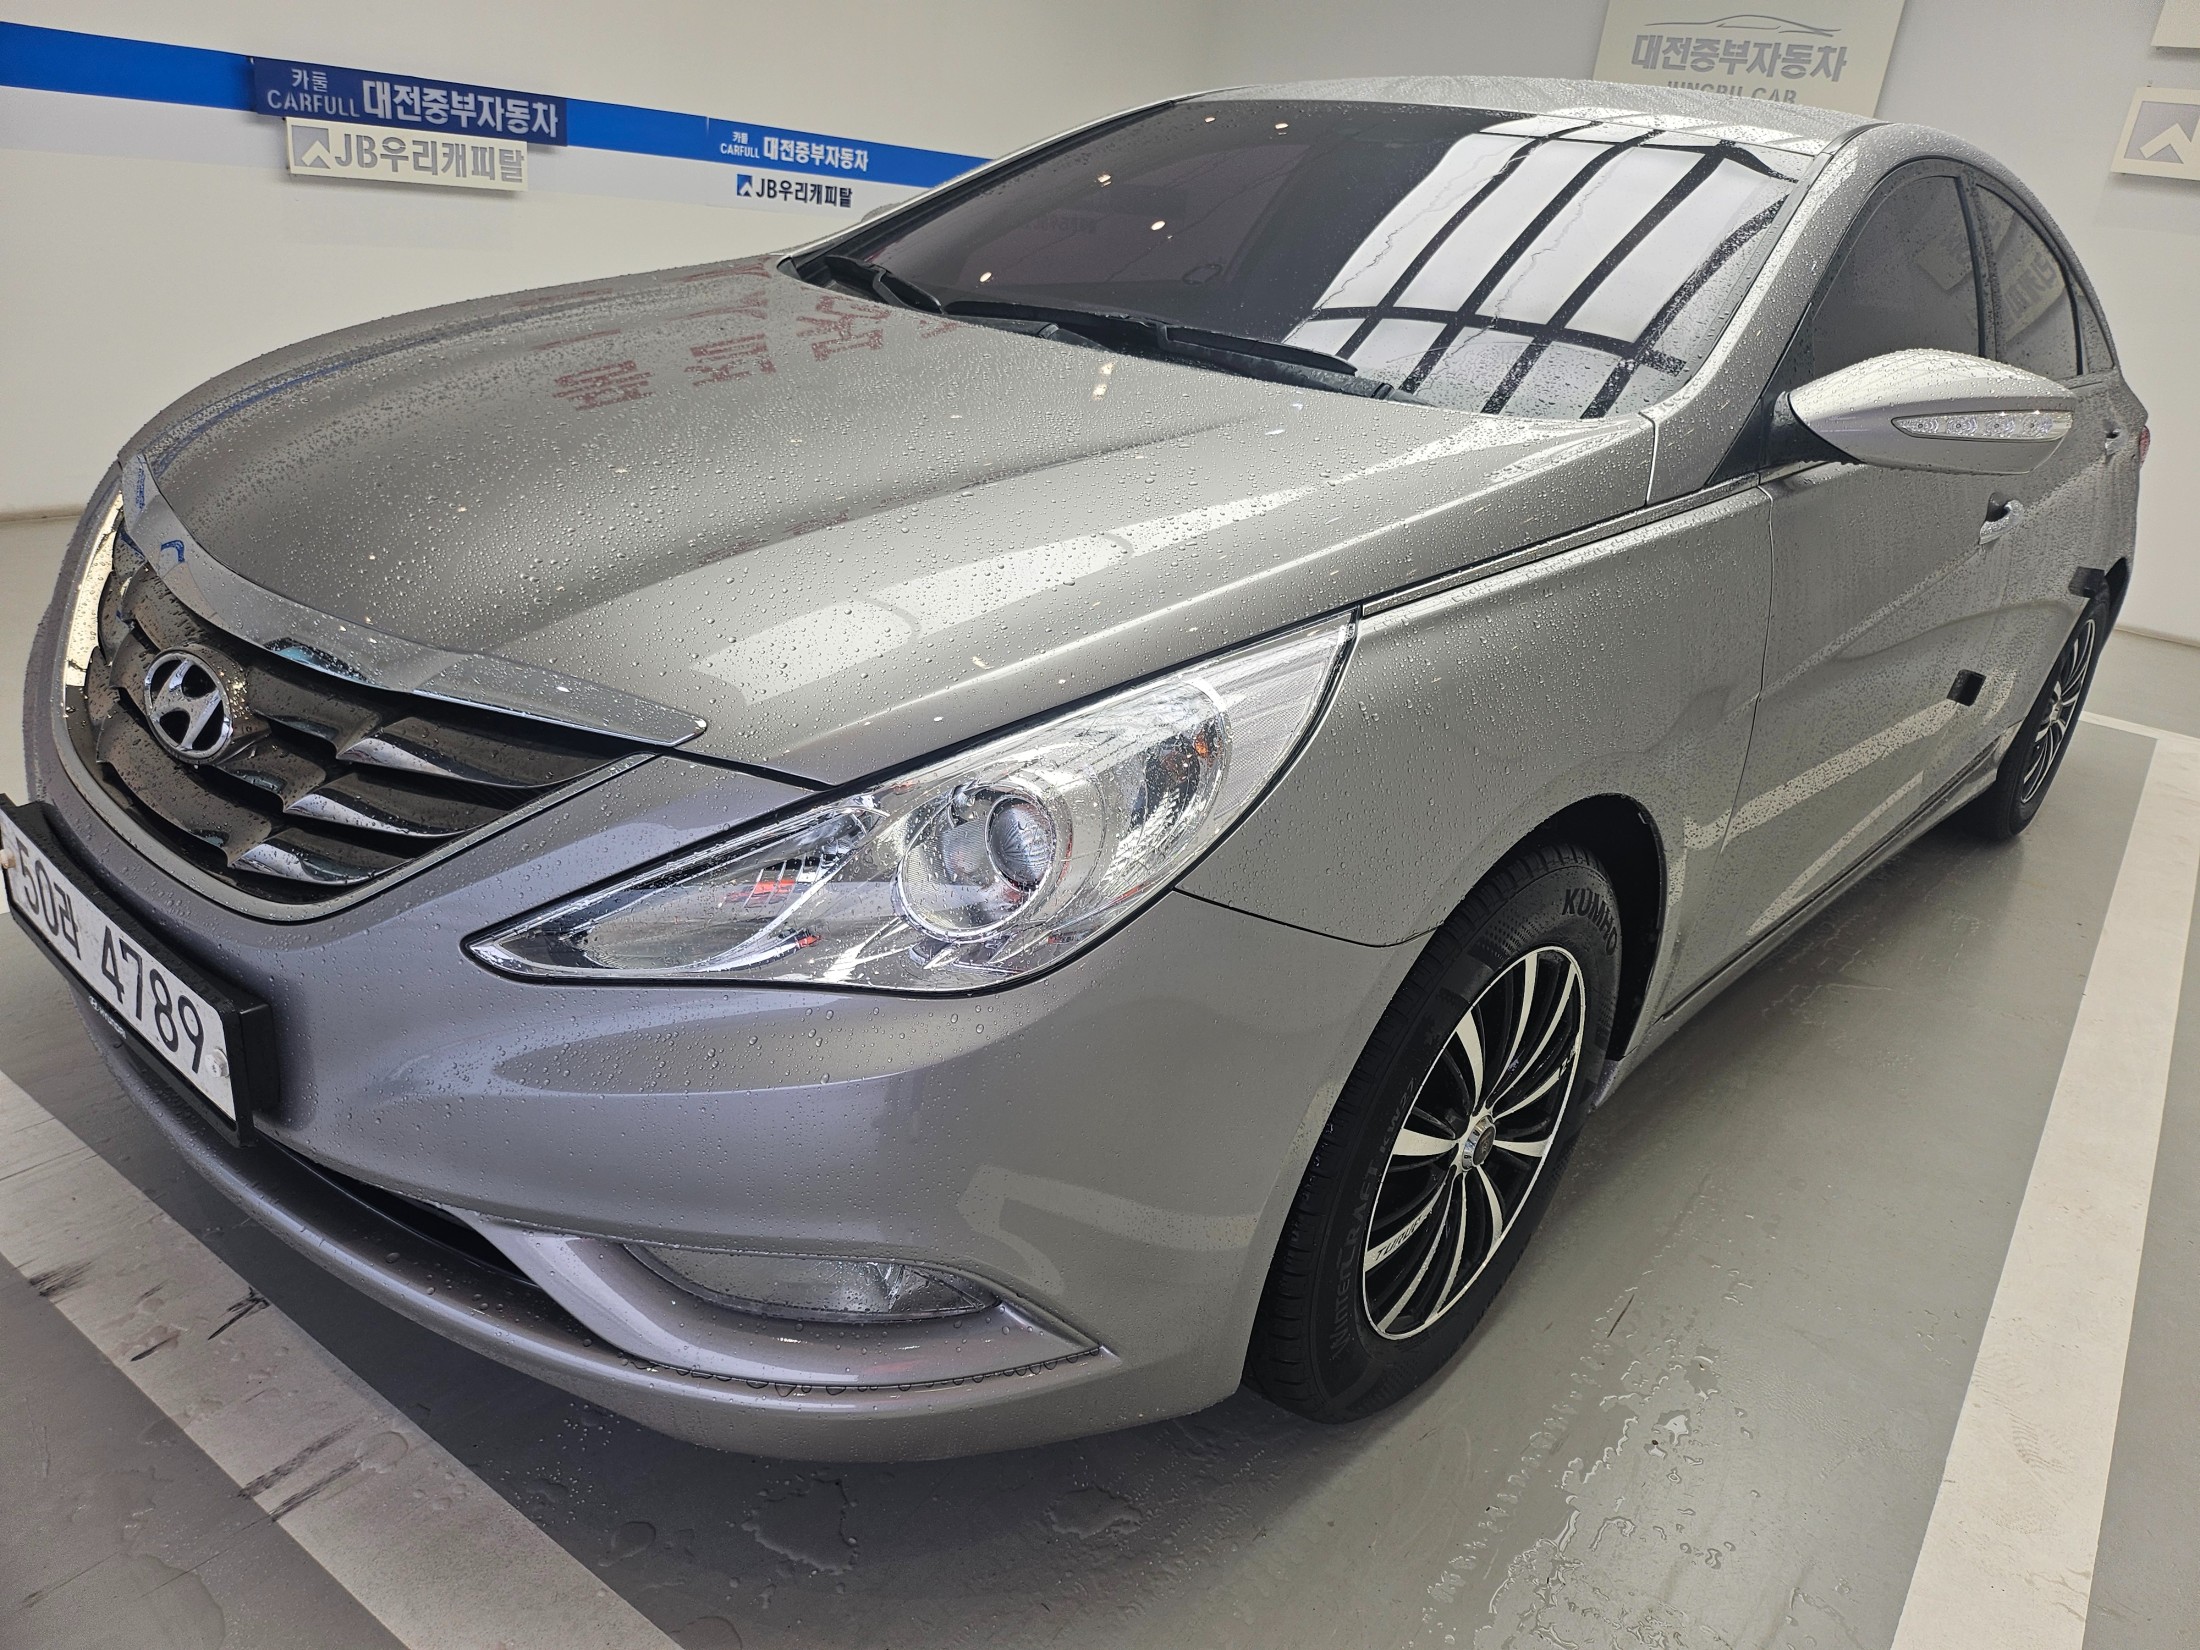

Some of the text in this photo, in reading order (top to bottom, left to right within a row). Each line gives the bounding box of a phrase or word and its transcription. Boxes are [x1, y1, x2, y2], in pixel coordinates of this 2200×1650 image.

[1631, 34, 1847, 82] 대전중부자동차
[267, 90, 360, 118] CARFULL
[362, 79, 558, 138] 대전중부자동차
[334, 132, 524, 183] JB우리캐피탈
[720, 142, 760, 159] CARFULL
[763, 136, 869, 172] 대전중부자동차
[756, 178, 852, 208] JB우리캐피탈
[1561, 888, 1618, 956] KUMHO
[15, 837, 204, 1074] 50라 4789
